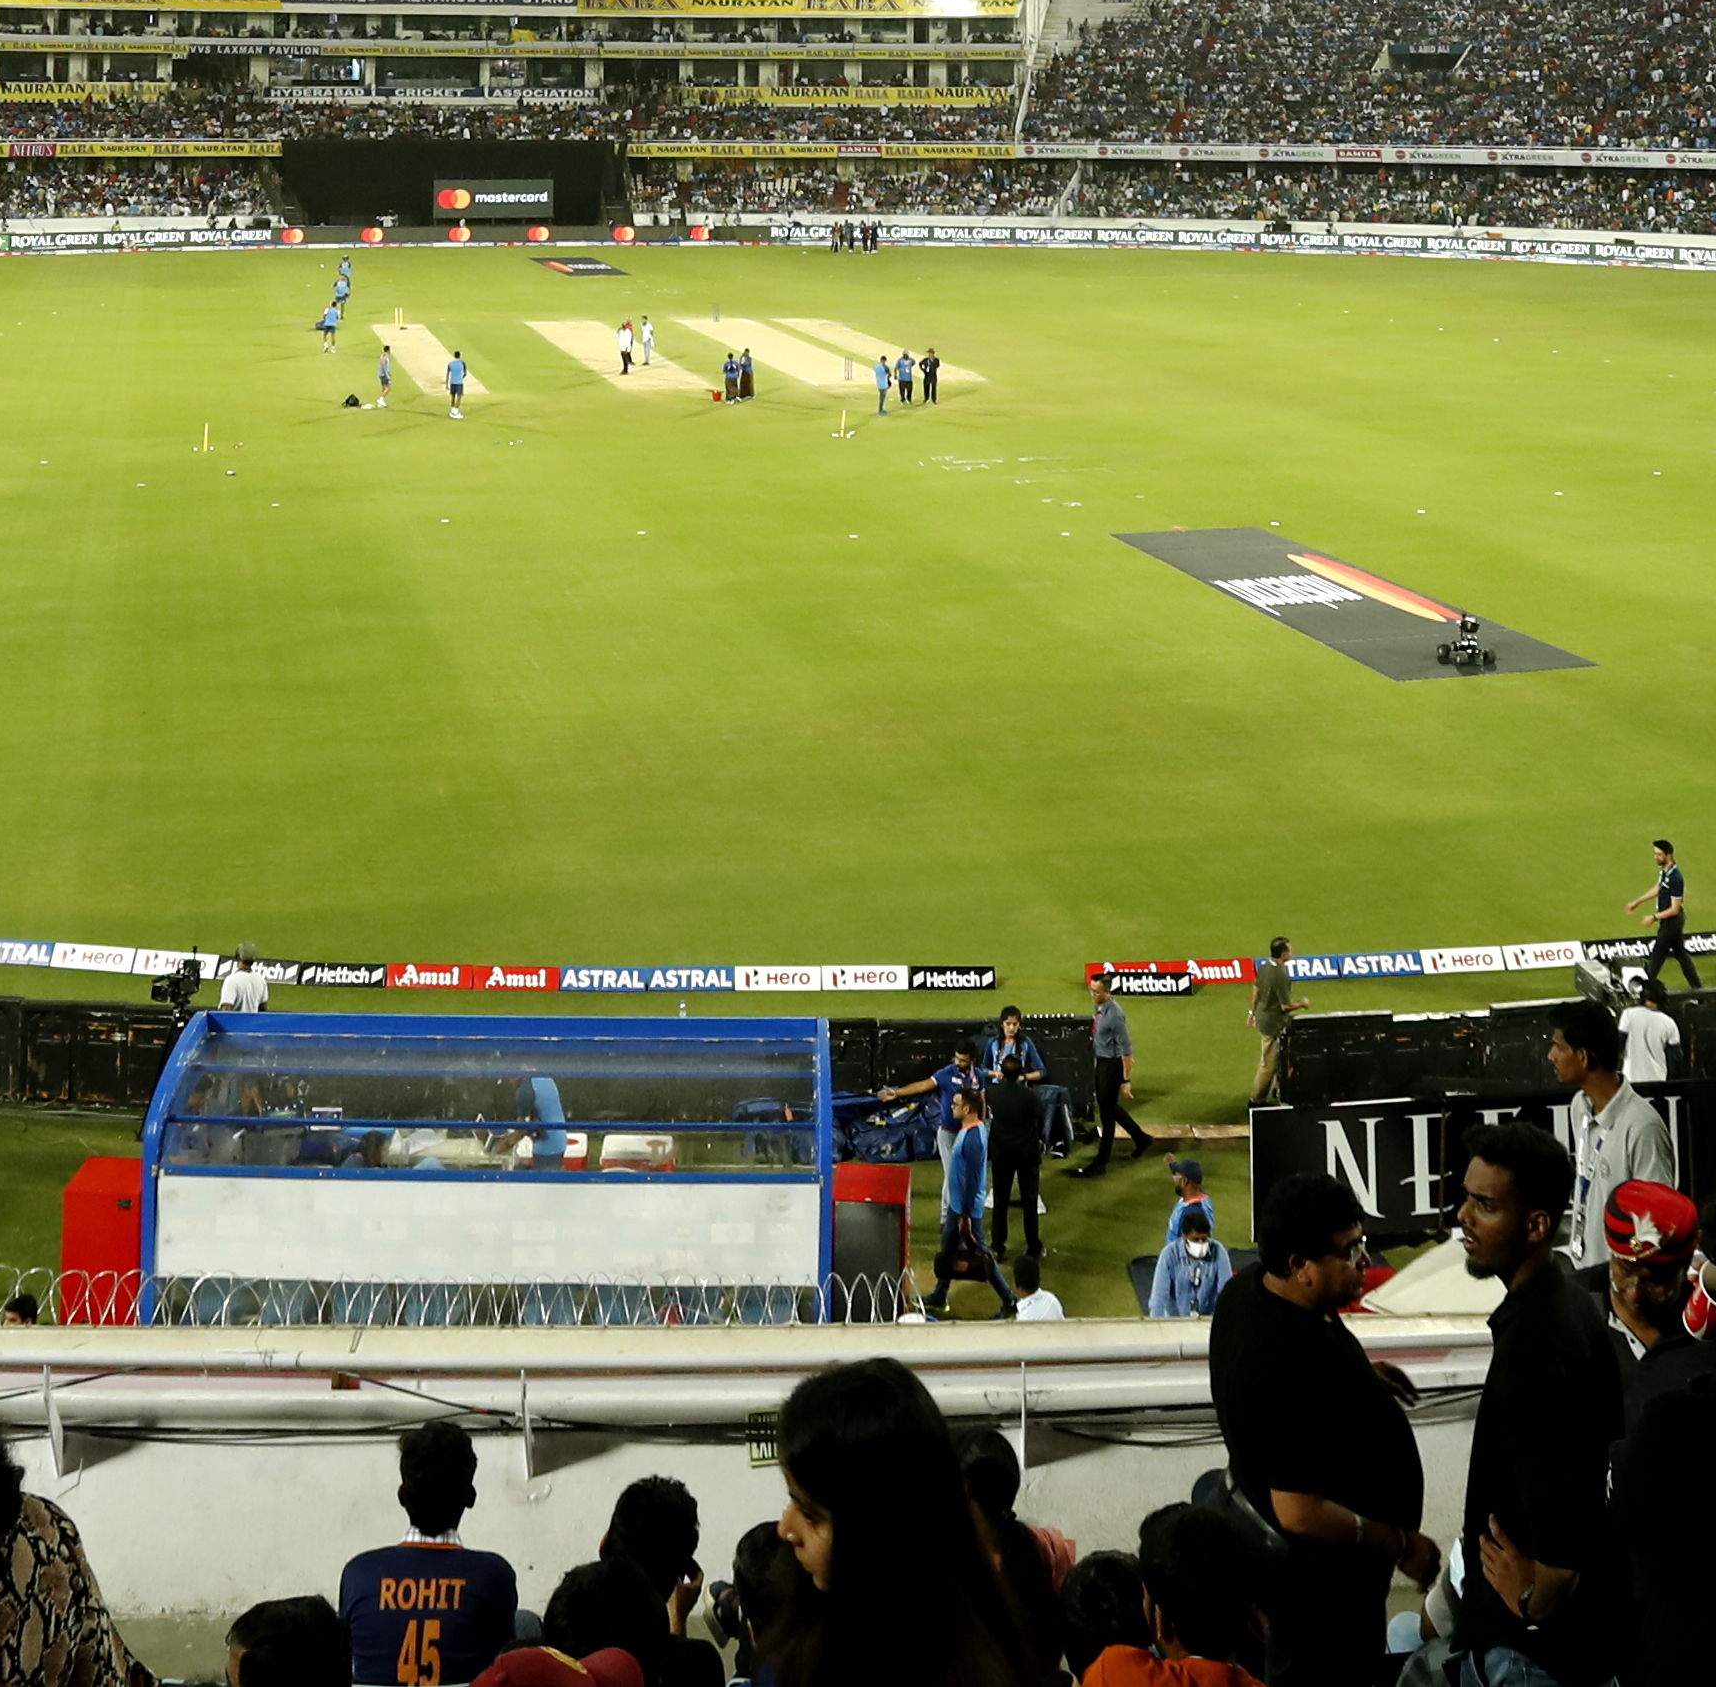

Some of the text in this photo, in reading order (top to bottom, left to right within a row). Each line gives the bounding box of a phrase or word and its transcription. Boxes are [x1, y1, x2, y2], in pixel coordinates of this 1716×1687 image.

[190, 46, 211, 54] VVS
[217, 46, 262, 55] LAXMAN
[269, 46, 319, 55] PAVILION
[2, 82, 86, 94] NAURATAN
[270, 88, 595, 98] HYDERABAD CRICKET ASSOCIATION
[770, 87, 849, 98] NAURATAN
[475, 191, 548, 203] mastercard
[190, 229, 271, 243] ROYAL GREEN
[933, 227, 1011, 240] ROYAL GREEN
[1344, 235, 1422, 249] ROYAL GREEN
[81, 949, 124, 965] Hero
[1452, 952, 1494, 967] Hero
[1533, 947, 1575, 963] Hero
[1187, 960, 1243, 979] Amul
[1343, 953, 1421, 975] ASTRAL
[315, 965, 370, 986] Hettich
[404, 964, 459, 986] Amul
[485, 966, 547, 988] Amul
[562, 969, 645, 989] ASTRAL
[650, 969, 732, 988] ASTRAL
[767, 972, 811, 985] Hero
[854, 971, 898, 984] Hero
[926, 971, 984, 989] Hettich
[1122, 974, 1180, 993] Hettich
[379, 1578, 466, 1611] ROHIT
[397, 1619, 441, 1687] 45
